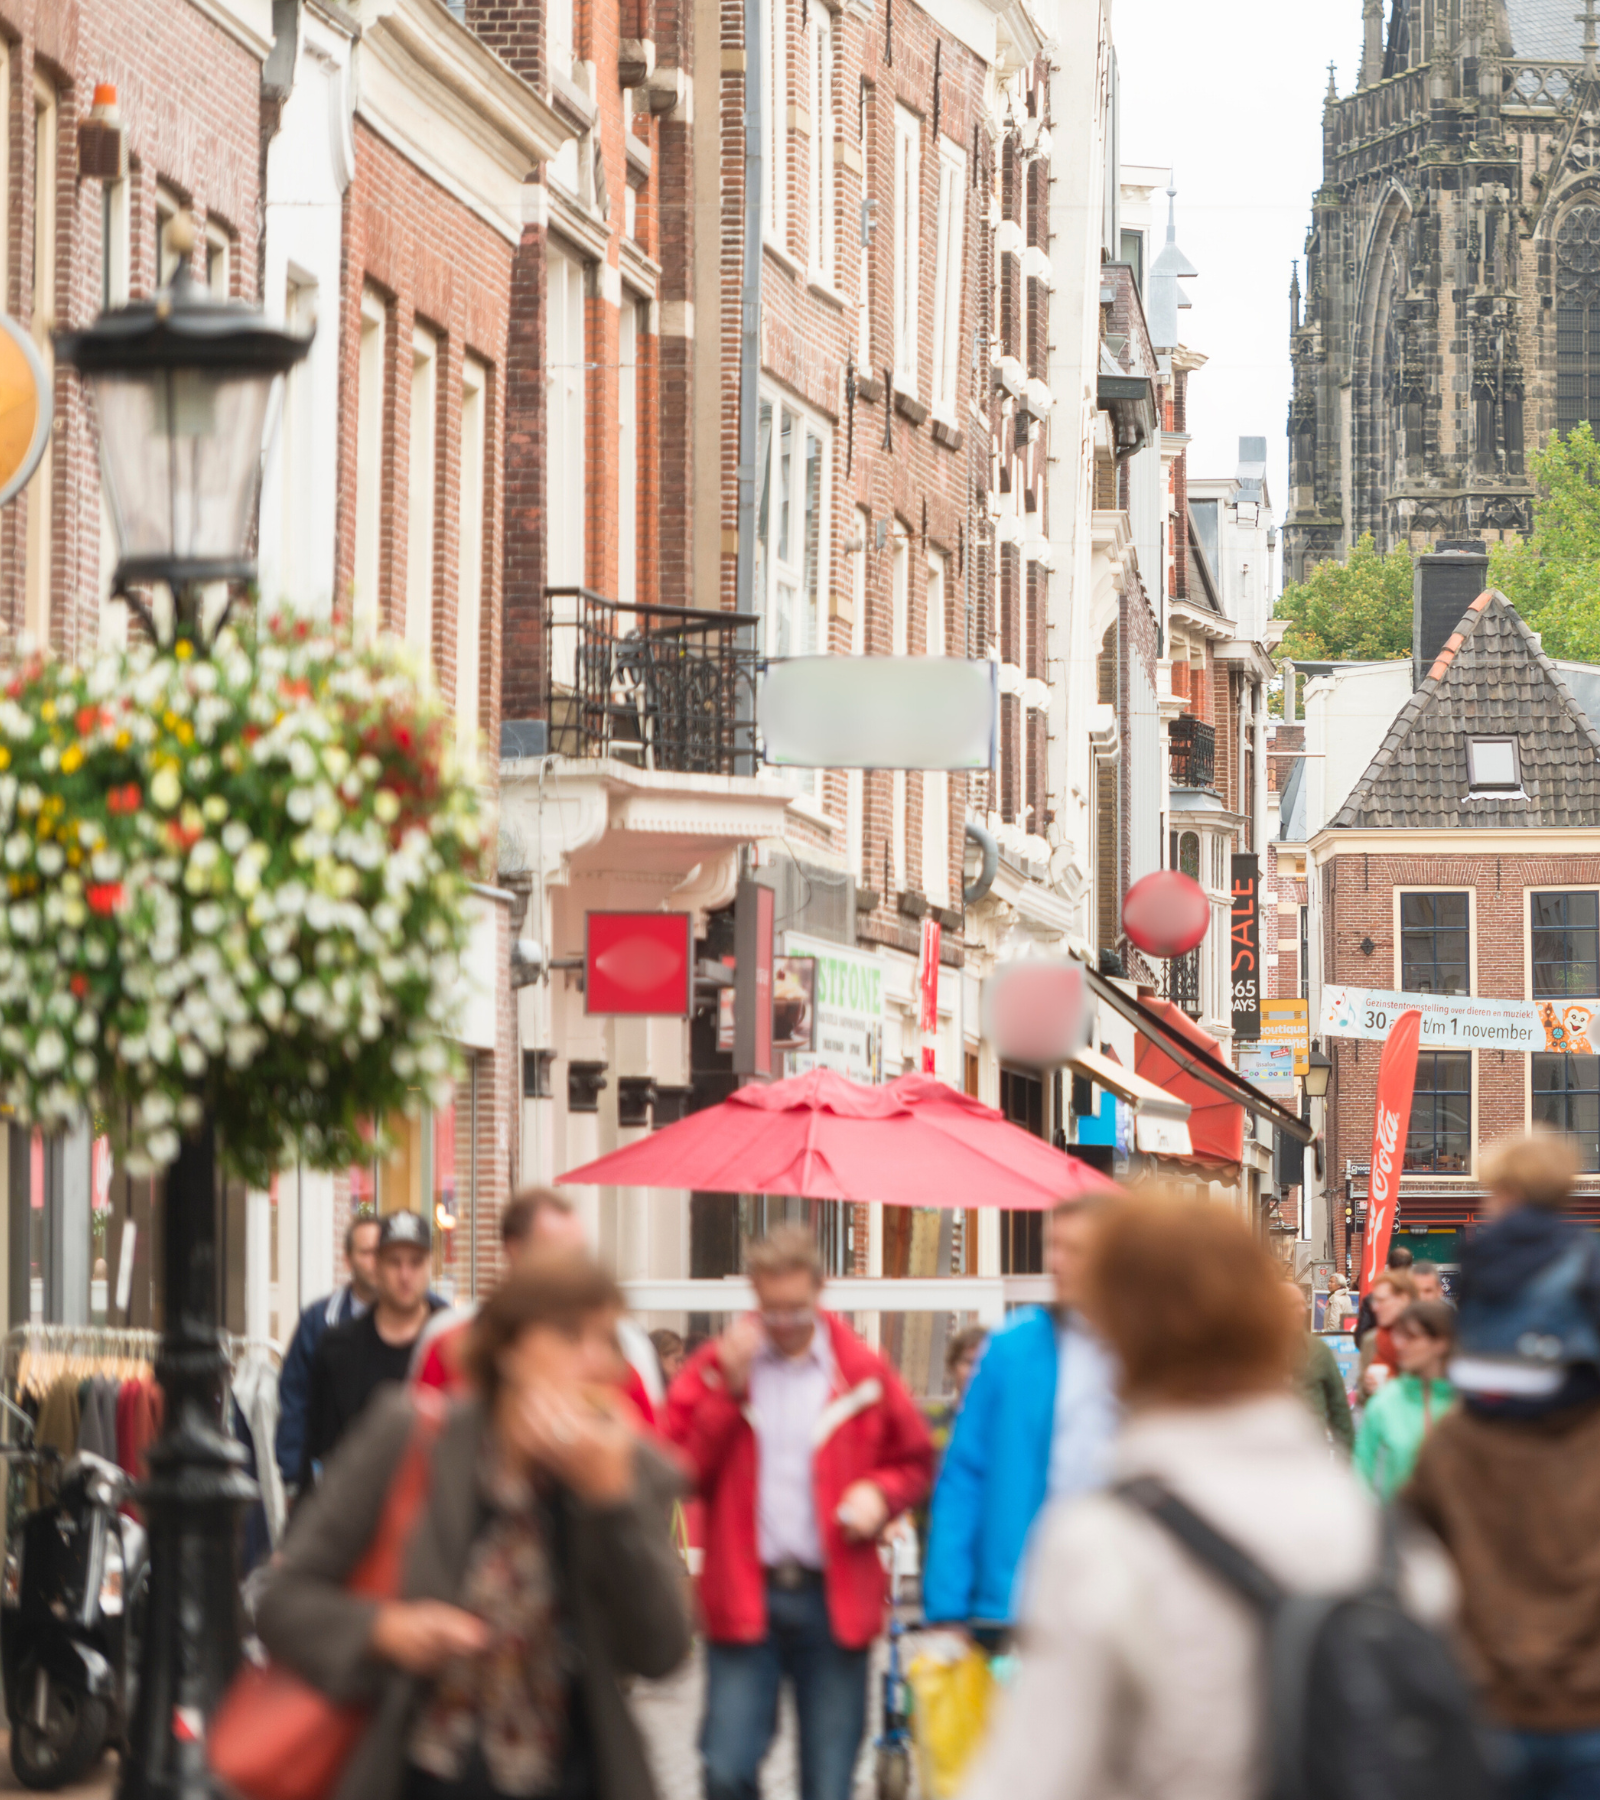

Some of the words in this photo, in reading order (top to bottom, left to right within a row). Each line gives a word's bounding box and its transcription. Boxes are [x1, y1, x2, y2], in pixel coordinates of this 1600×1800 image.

[1231, 878, 1255, 971] SALE
[1231, 999, 1257, 1012] AYS
[1466, 1006, 1492, 1017] dieren
[1503, 1009, 1534, 1019] muziek!
[1364, 1010, 1387, 1030] 30
[1423, 1018, 1446, 1035] t/m
[1450, 1018, 1458, 1036] 1
[1462, 1023, 1534, 1041] november
